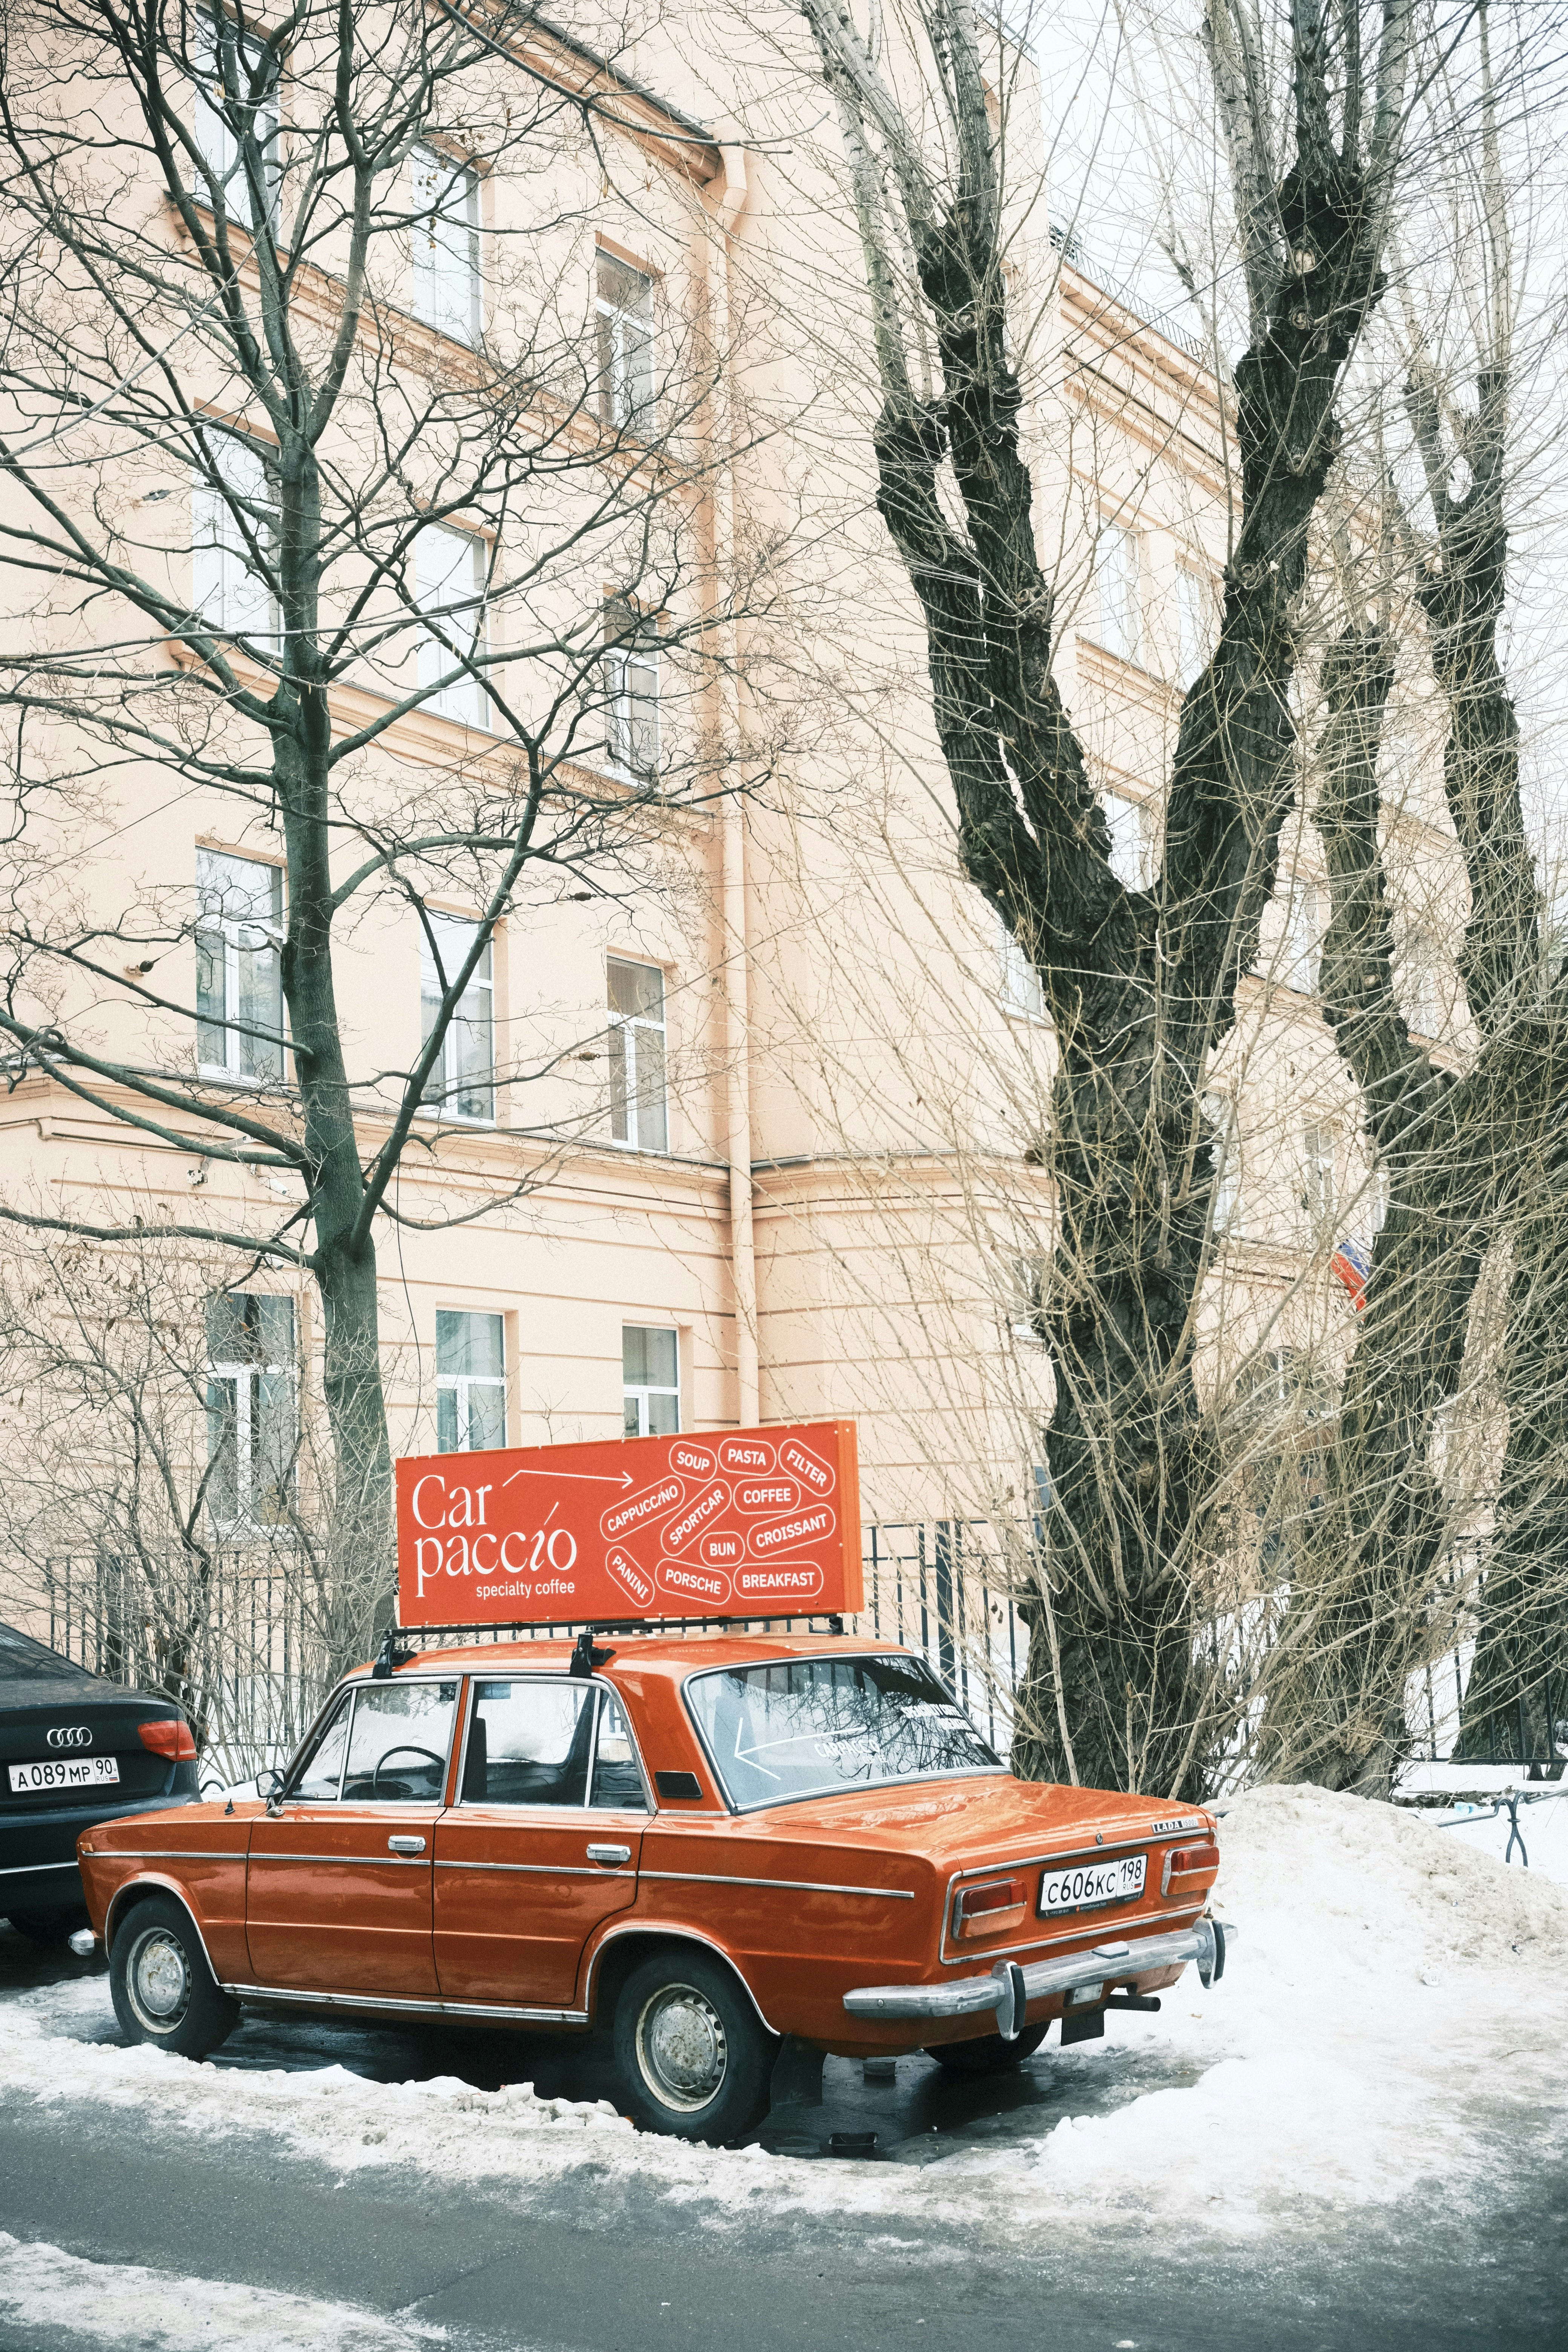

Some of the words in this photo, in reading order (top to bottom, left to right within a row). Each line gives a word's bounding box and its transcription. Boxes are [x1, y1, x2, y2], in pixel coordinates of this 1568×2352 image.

[677, 1451, 710, 1471] SOUP
[728, 1449, 766, 1466] PASTA
[787, 1449, 827, 1487] FILTER
[412, 1475, 493, 1529] Car
[743, 1488, 791, 1504] COFFEE
[669, 1489, 724, 1545] SPORTCAR
[756, 1513, 827, 1547] CROISSANT
[710, 1542, 735, 1556] BUN
[612, 1555, 649, 1599] PANINI
[665, 1569, 721, 1594] PORSCHE
[742, 1573, 815, 1588] BREAKFAST
[476, 1580, 531, 1600] specialty
[535, 1579, 575, 1595] coffee
[814, 1739, 880, 1758] CARPACCO
[95, 1759, 112, 1775] 90
[862, 1754, 888, 1764] COFEE
[1156, 1821, 1180, 1831] LADA
[1121, 1859, 1142, 1882] 198
[1122, 1882, 1134, 1891] RUS
